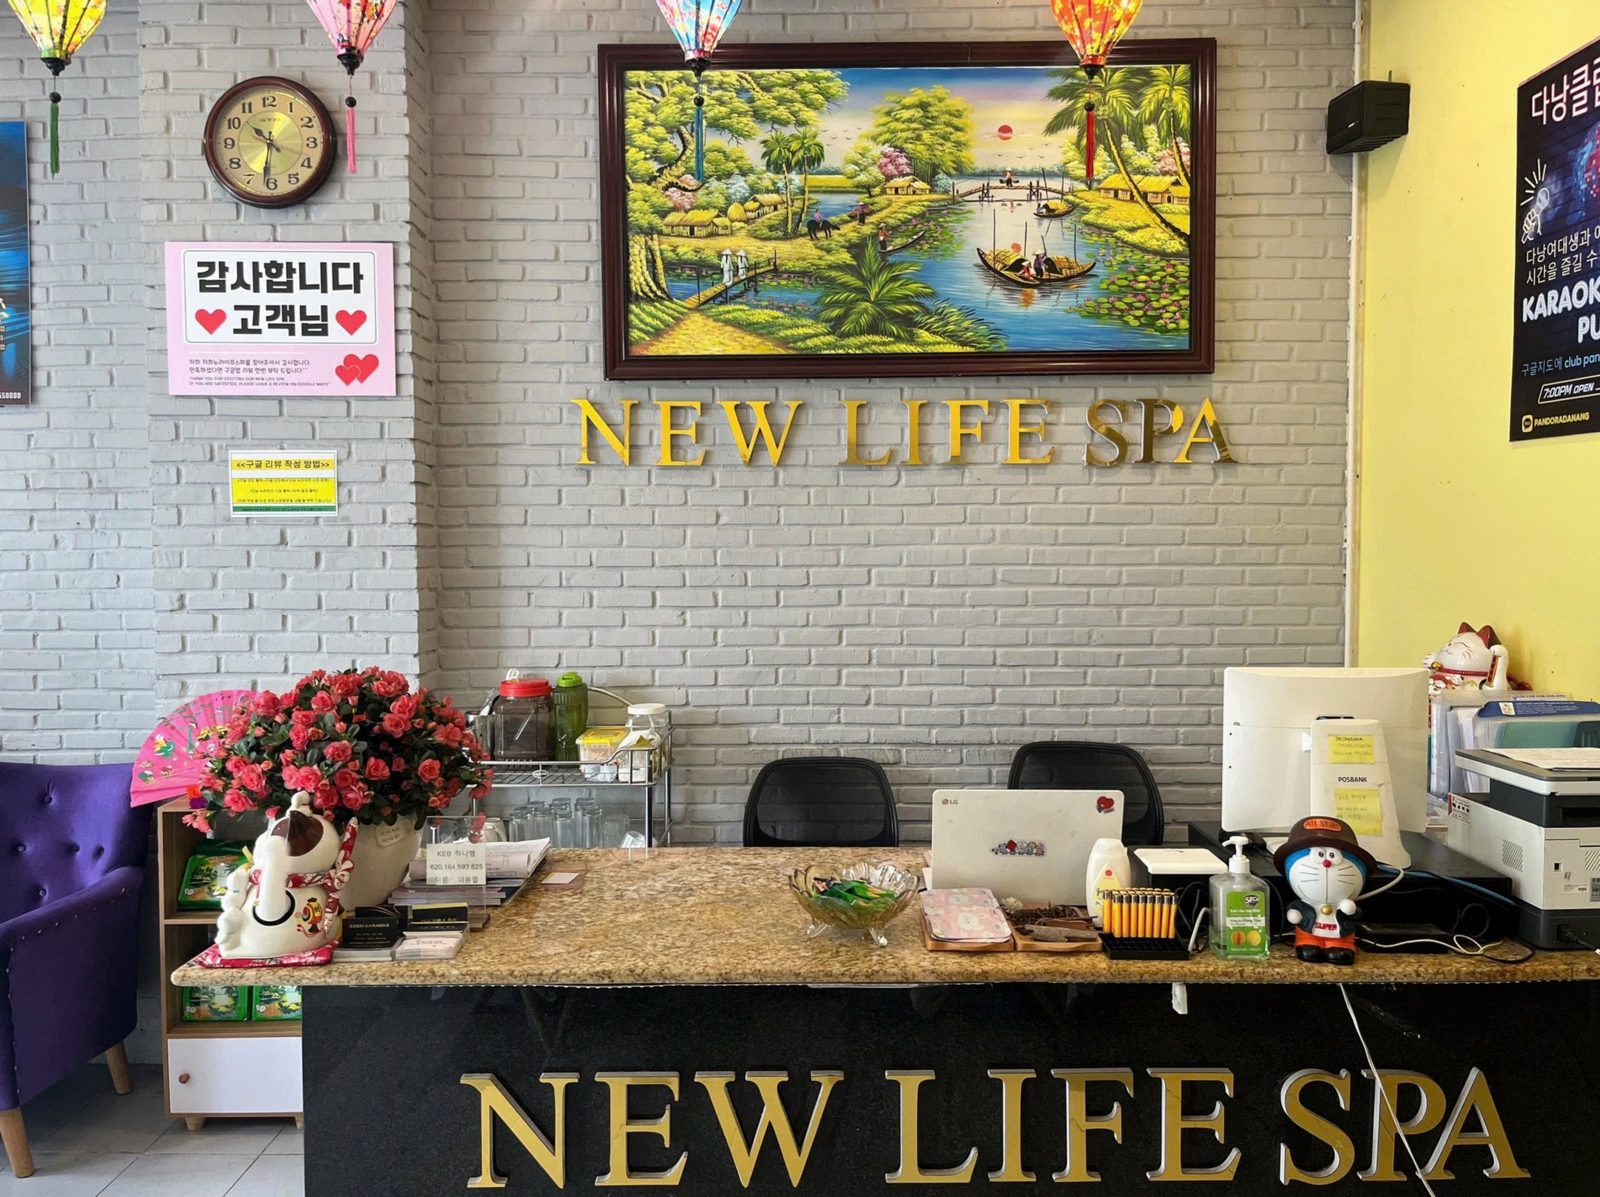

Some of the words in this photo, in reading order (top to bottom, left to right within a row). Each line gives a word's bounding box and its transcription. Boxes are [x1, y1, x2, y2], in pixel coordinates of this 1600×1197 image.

[242, 102, 252, 114] 11
[262, 96, 277, 108] 12
[288, 101, 294, 113] 1
[227, 116, 241, 130] 10
[300, 116, 314, 128] 2
[224, 138, 235, 150] 9
[306, 137, 318, 149] 3
[229, 158, 241, 170] 8
[301, 157, 312, 168] 4
[244, 174, 256, 184] 7
[266, 178, 278, 190] 6
[288, 172, 300, 185] 5
[1526, 227, 1591, 265] 다낭여대생과
[1526, 262, 1558, 286] 시간을
[1561, 252, 1582, 277] 즐길
[1586, 249, 1598, 268] 수
[197, 260, 364, 294] 감사합니다
[233, 304, 329, 336] 고객님
[1522, 356, 1562, 377] 구글지도에
[1564, 355, 1582, 368] club
[1543, 384, 1573, 400] 7:00PM
[1573, 382, 1594, 394] OPEN
[1534, 412, 1590, 426] PANDORADANANG
[571, 399, 802, 467] NEW
[838, 399, 1057, 466] LIFE
[1083, 397, 1239, 466] SPA
[265, 460, 282, 468] 리뷰
[1314, 922, 1338, 930] SUPER
[459, 1069, 844, 1189] NEW
[884, 1068, 1241, 1184] LIFE
[1278, 1066, 1531, 1185] SPA
